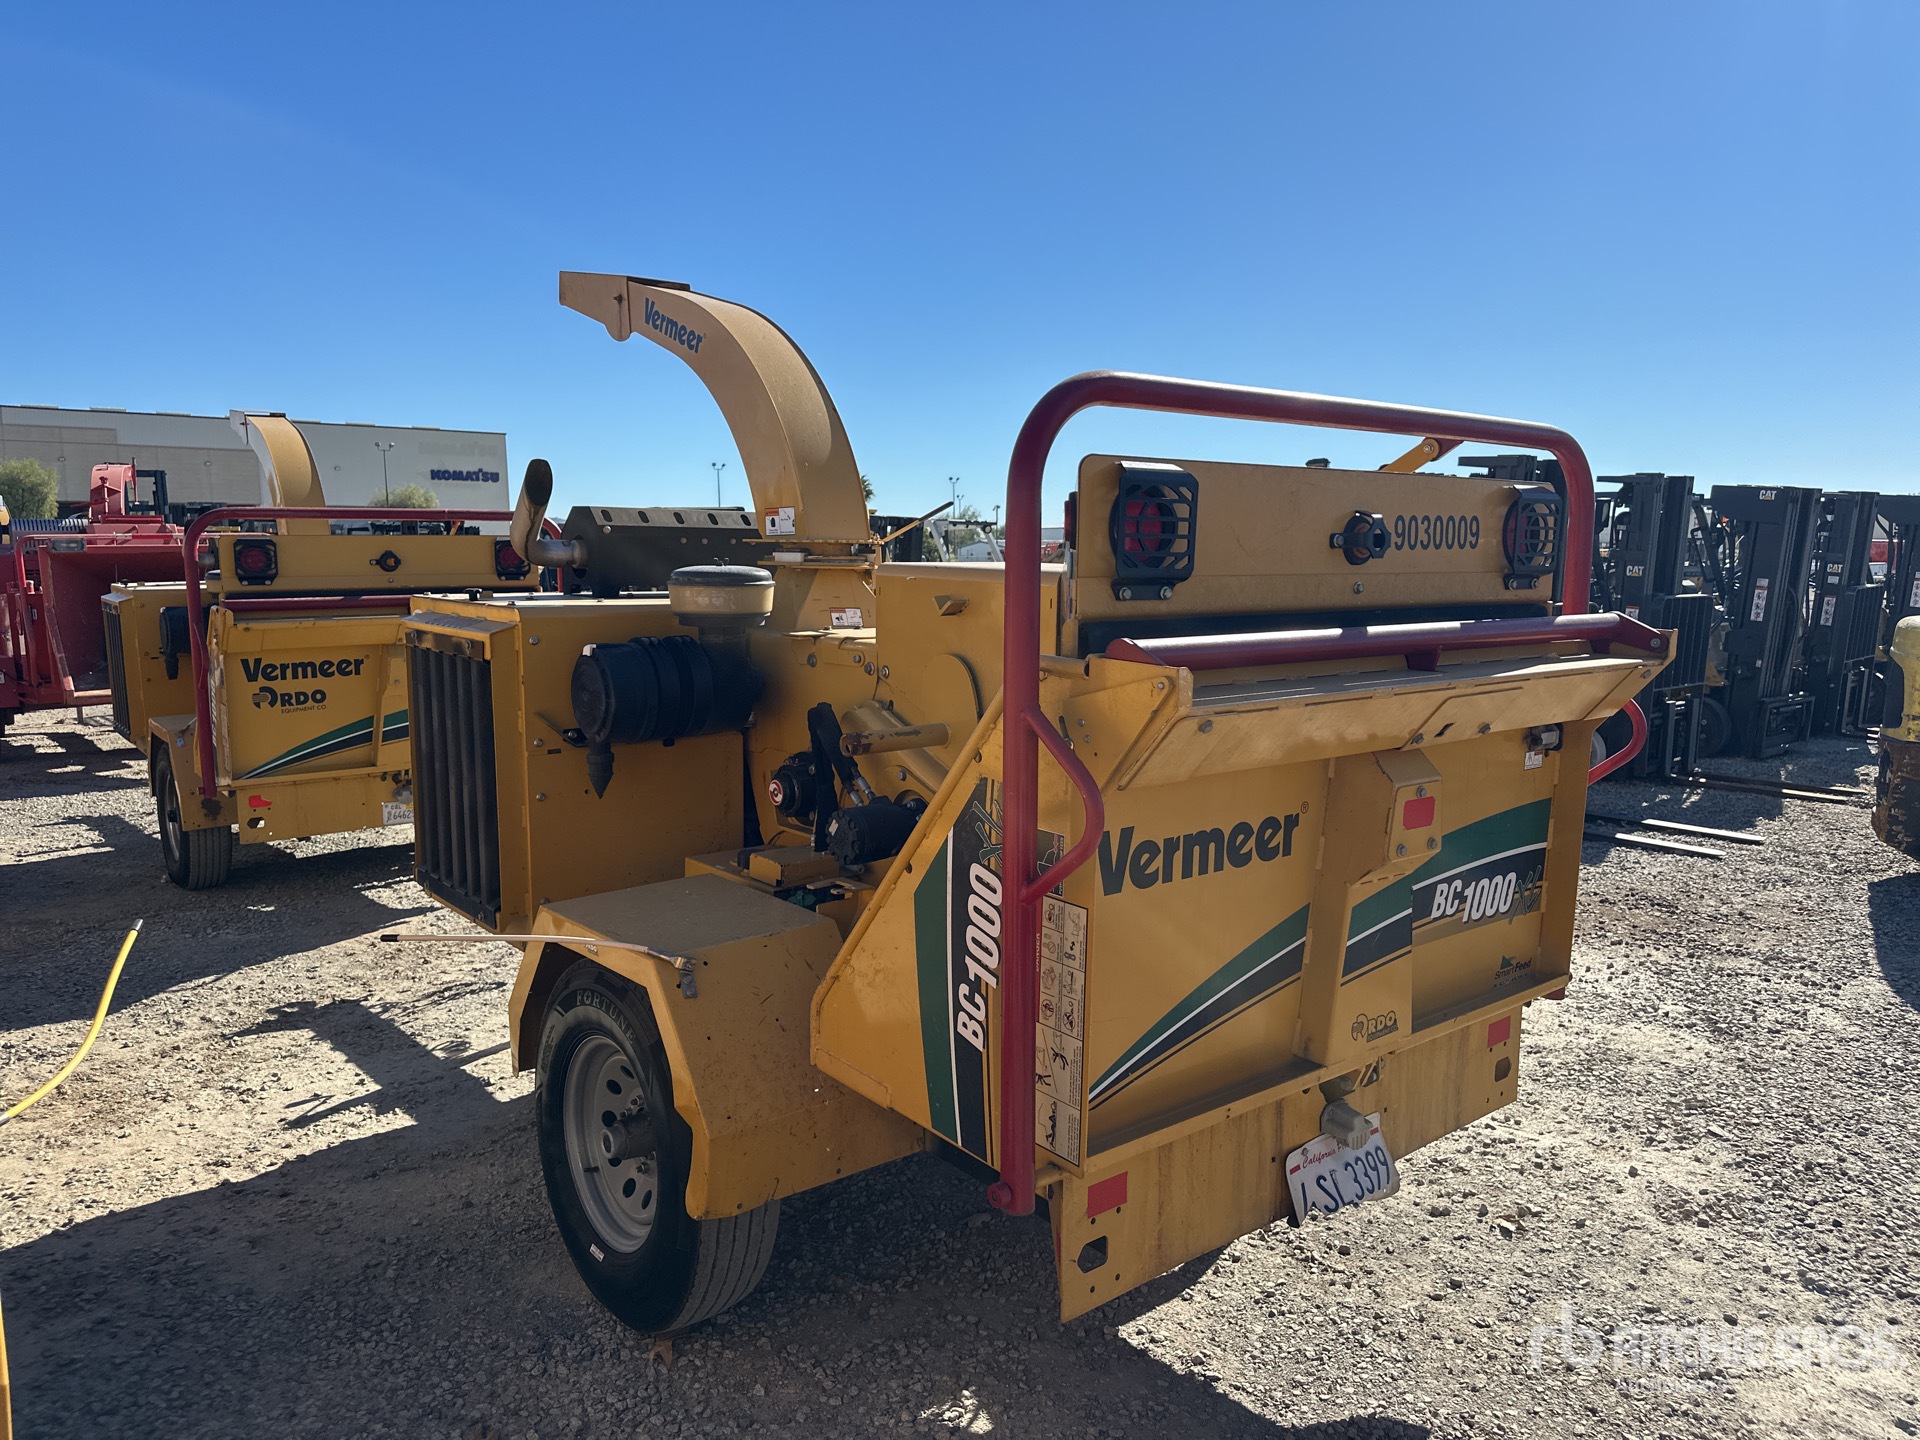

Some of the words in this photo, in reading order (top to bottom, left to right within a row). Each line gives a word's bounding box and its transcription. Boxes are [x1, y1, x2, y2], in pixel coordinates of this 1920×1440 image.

[645, 297, 703, 354] Vermeer
[430, 468, 500, 483] KOMATSU
[1759, 489, 1777, 501] CAT
[1394, 514, 1480, 551] 9030009
[1626, 565, 1645, 577] CAT
[1826, 563, 1844, 573] CAT
[240, 657, 365, 683] Vermeer
[1097, 812, 1300, 897] Vermeer
[576, 989, 637, 1045] FORTUNE
[1302, 1148, 1337, 1169] California
